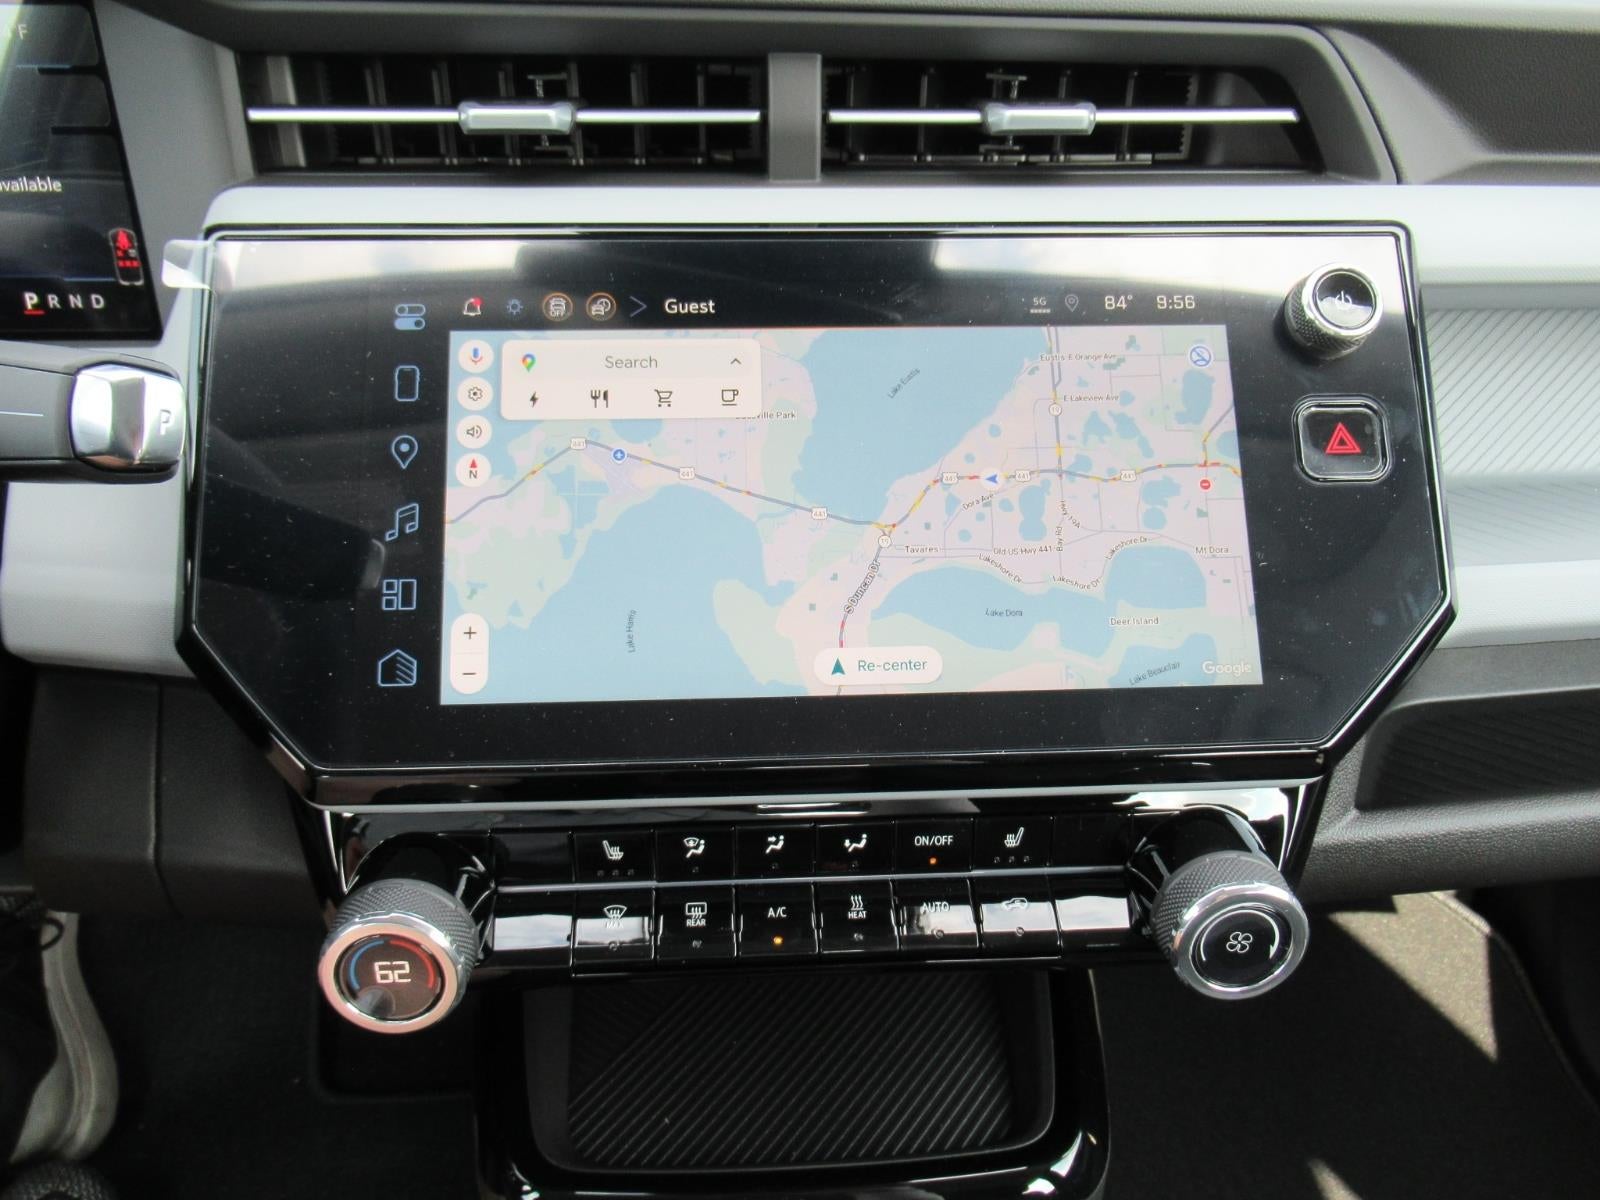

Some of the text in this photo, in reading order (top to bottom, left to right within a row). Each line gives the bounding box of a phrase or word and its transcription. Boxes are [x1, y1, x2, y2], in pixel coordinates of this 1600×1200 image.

[0, 175, 62, 192] vailable
[24, 291, 105, 310] P R N D
[665, 298, 716, 314] Guest
[1033, 297, 1047, 306] 5G
[1156, 295, 1196, 309] 9:56
[604, 354, 659, 369] Search
[776, 411, 795, 419] Park
[159, 409, 174, 436] P
[469, 470, 478, 479] N
[1017, 472, 1030, 480] 441
[904, 545, 939, 554] Tavares
[1008, 547, 1019, 556] US
[1020, 547, 1037, 555] Hwy
[1038, 545, 1053, 553] 441
[1104, 536, 1139, 560] Lakeshore
[1195, 546, 1230, 555] Mt Dora
[978, 552, 1023, 584] Lakeshore Dr
[844, 559, 880, 615] S Duncan Dr
[1052, 575, 1102, 591] Lakeshore Dr
[985, 608, 1024, 617] Lake Dora
[1110, 616, 1159, 626] Deer Island
[857, 658, 928, 673] Re-center
[1202, 660, 1252, 677] Google
[1128, 674, 1147, 686] Lake
[914, 835, 954, 847] ON/OFF
[768, 906, 787, 919] A/C
[920, 901, 950, 913] AUTO
[848, 911, 868, 920] HEAT
[686, 918, 707, 928] REAR
[373, 960, 412, 984] 62
